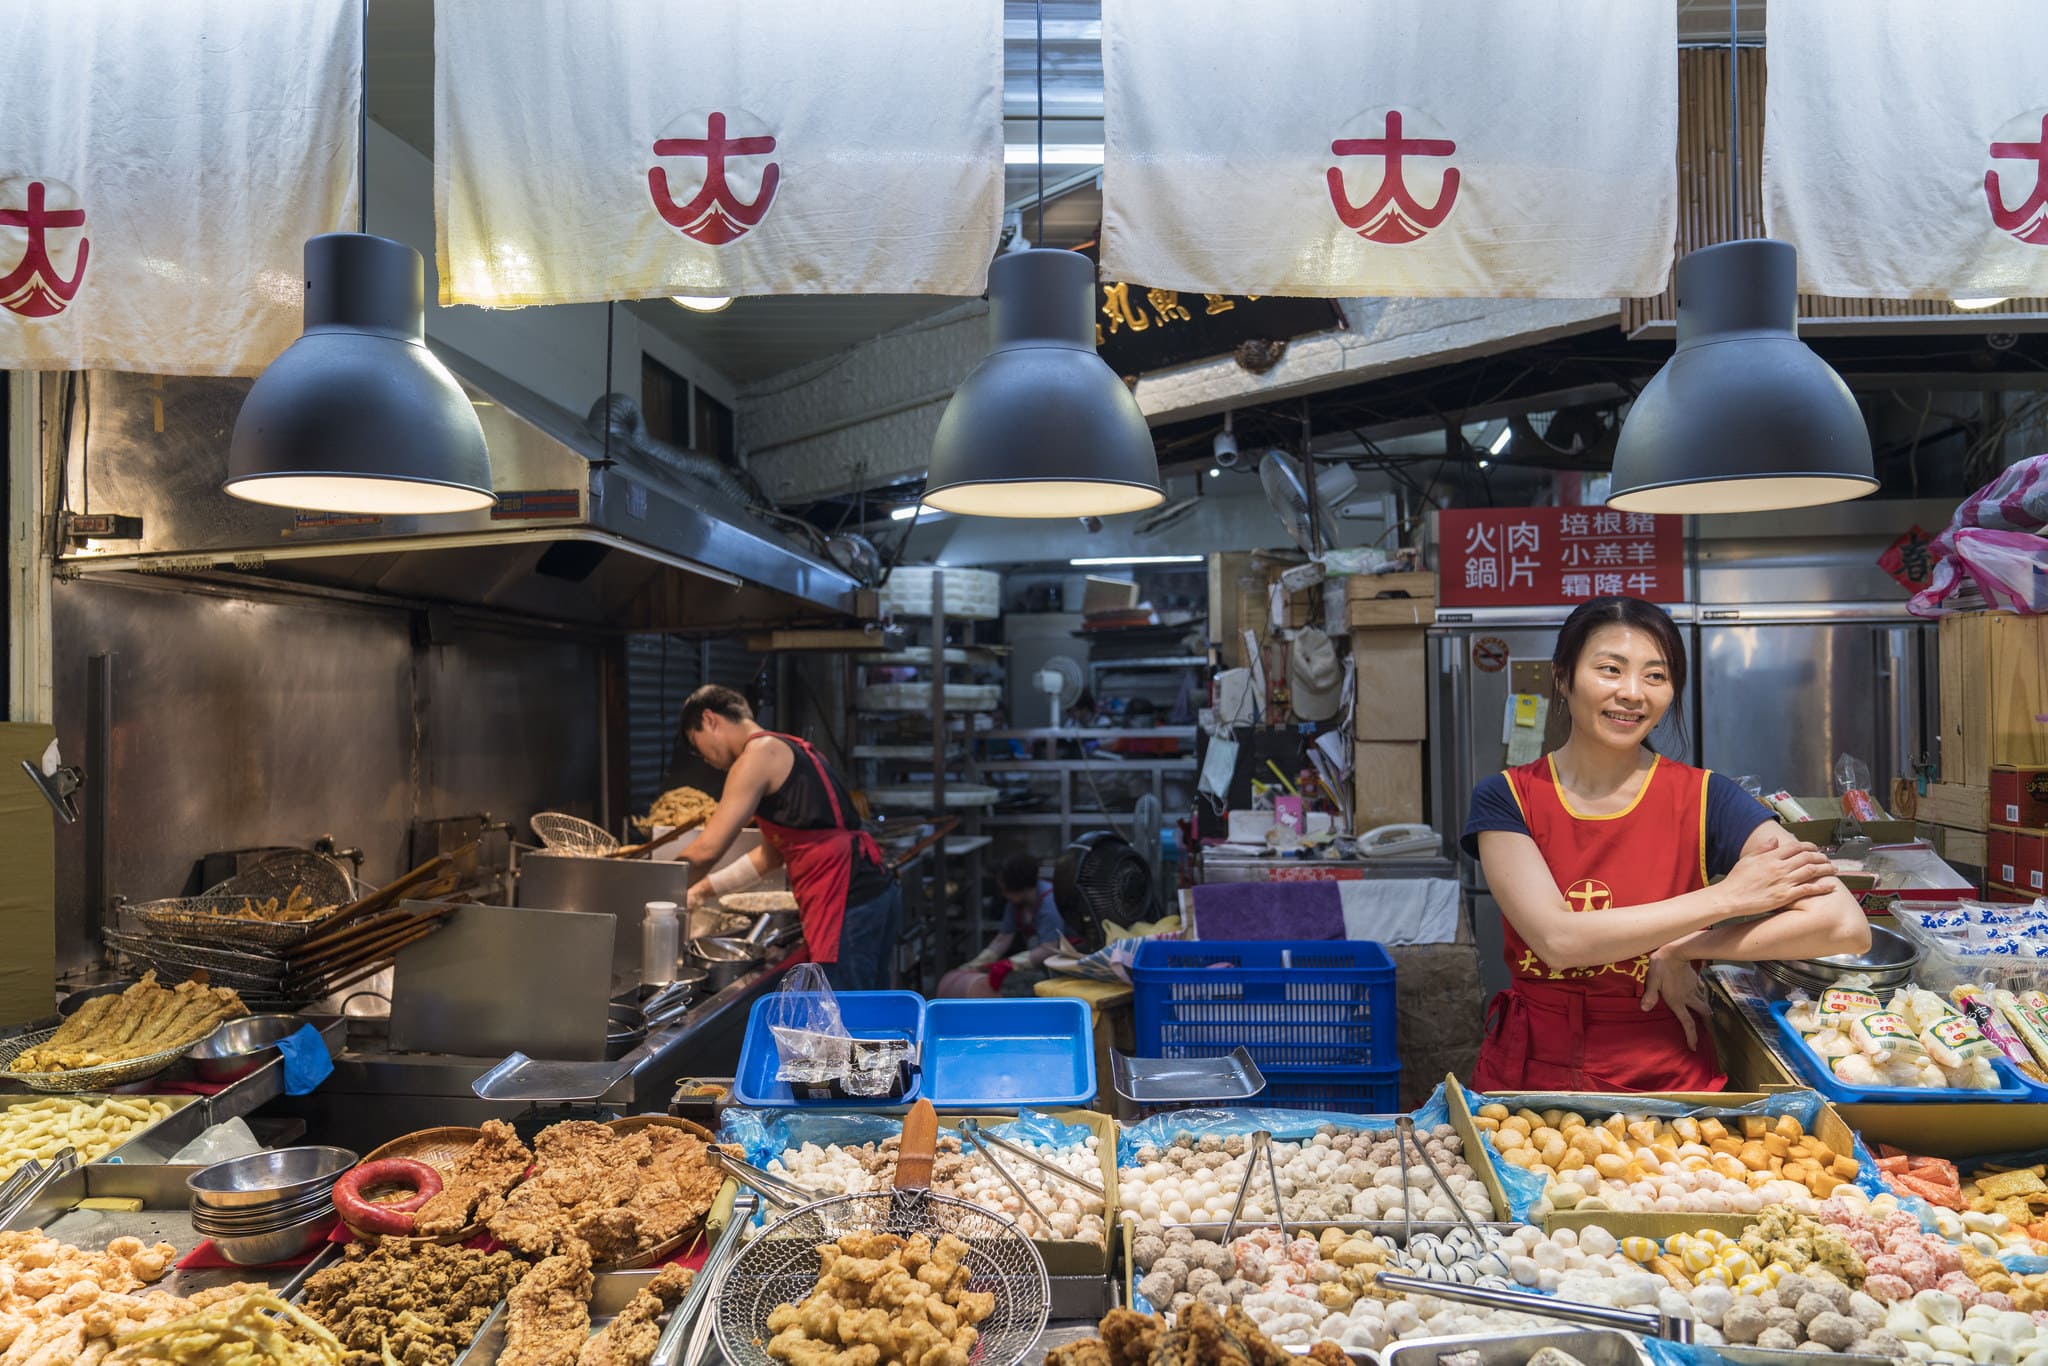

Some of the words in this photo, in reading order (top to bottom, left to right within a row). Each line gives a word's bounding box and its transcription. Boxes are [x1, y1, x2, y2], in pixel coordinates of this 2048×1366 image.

[1560, 512, 1655, 535] 培根豬
[1464, 521, 1498, 589] 火鍋
[1507, 520, 1541, 588] 肉片
[1560, 542, 1656, 566] 小羔羊
[1561, 572, 1657, 597] 霜降牛
